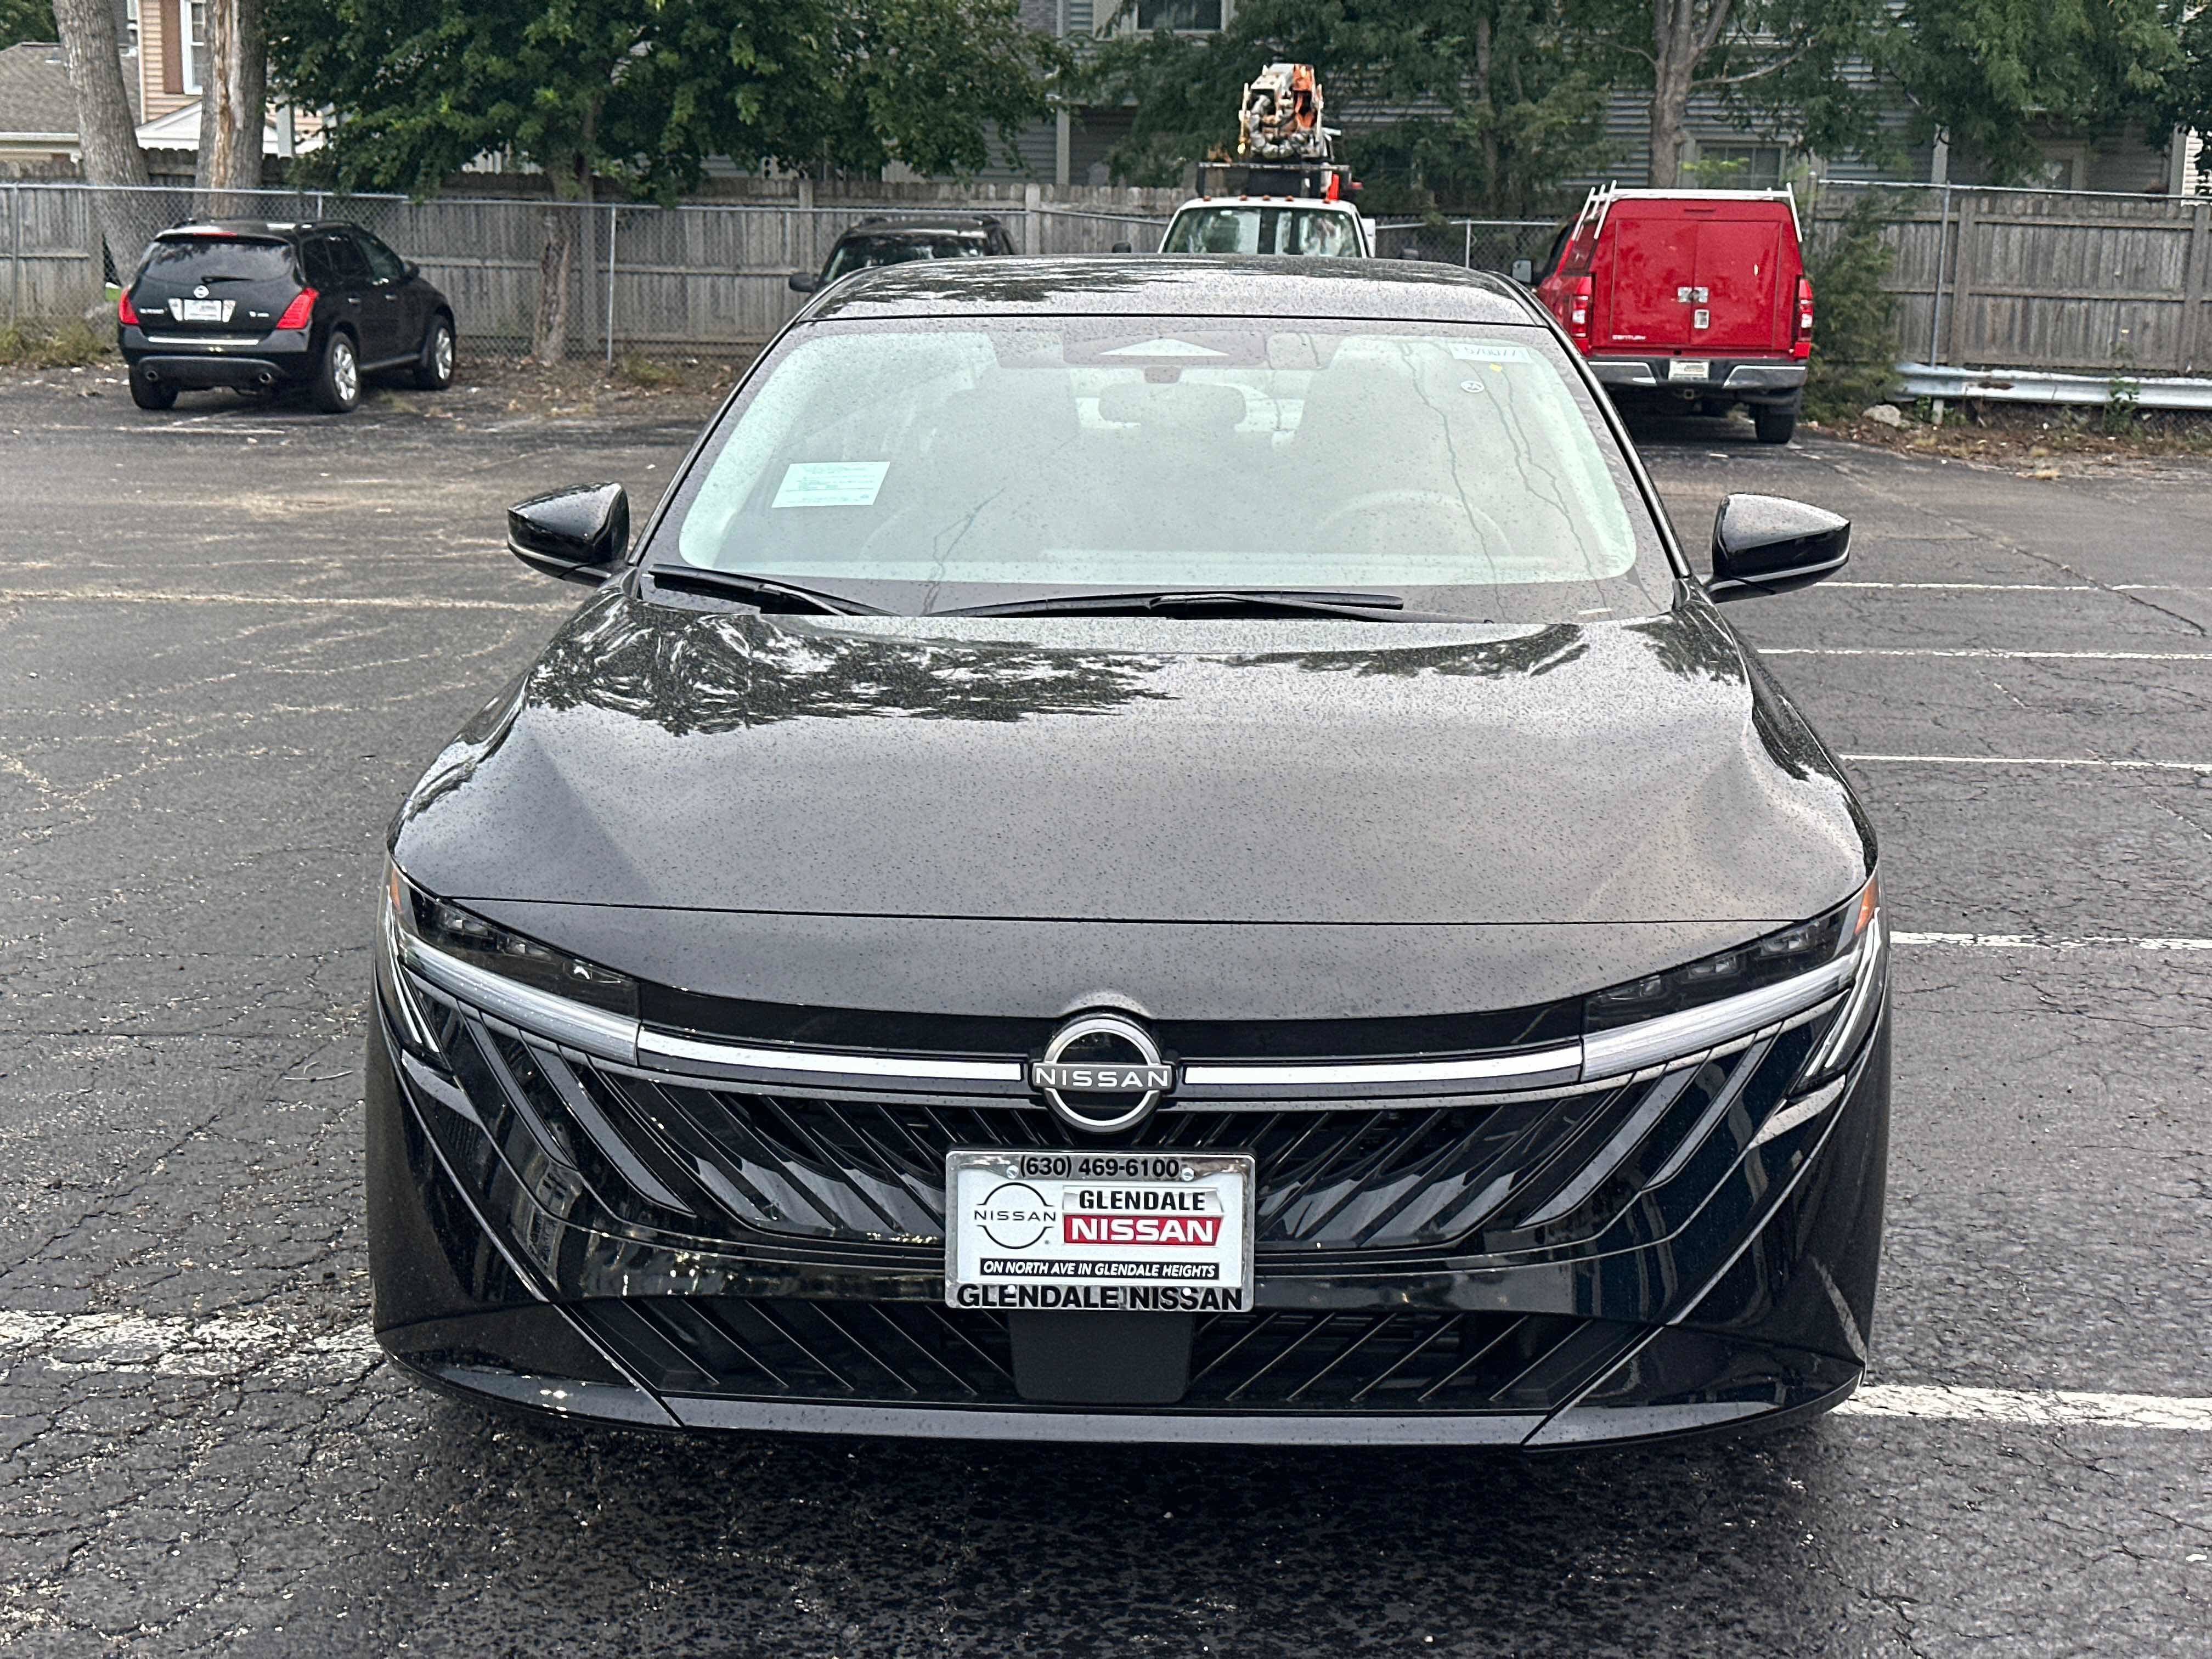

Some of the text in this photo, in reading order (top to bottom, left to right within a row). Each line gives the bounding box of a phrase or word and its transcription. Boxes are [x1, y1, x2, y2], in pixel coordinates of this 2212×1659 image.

[1036, 1067, 1167, 1087] NISSAN
[1020, 1155, 1180, 1178] (630) 469-6100
[1079, 1189, 1206, 1211] GLENDALE
[974, 1210, 1057, 1222] NISSAN
[1071, 1217, 1213, 1243] NISSAN
[984, 1261, 1216, 1278] ON NORTH AVE IN GLENDALE HEIGHTS
[957, 1283, 1243, 1311] GLENDALE NISSAN
